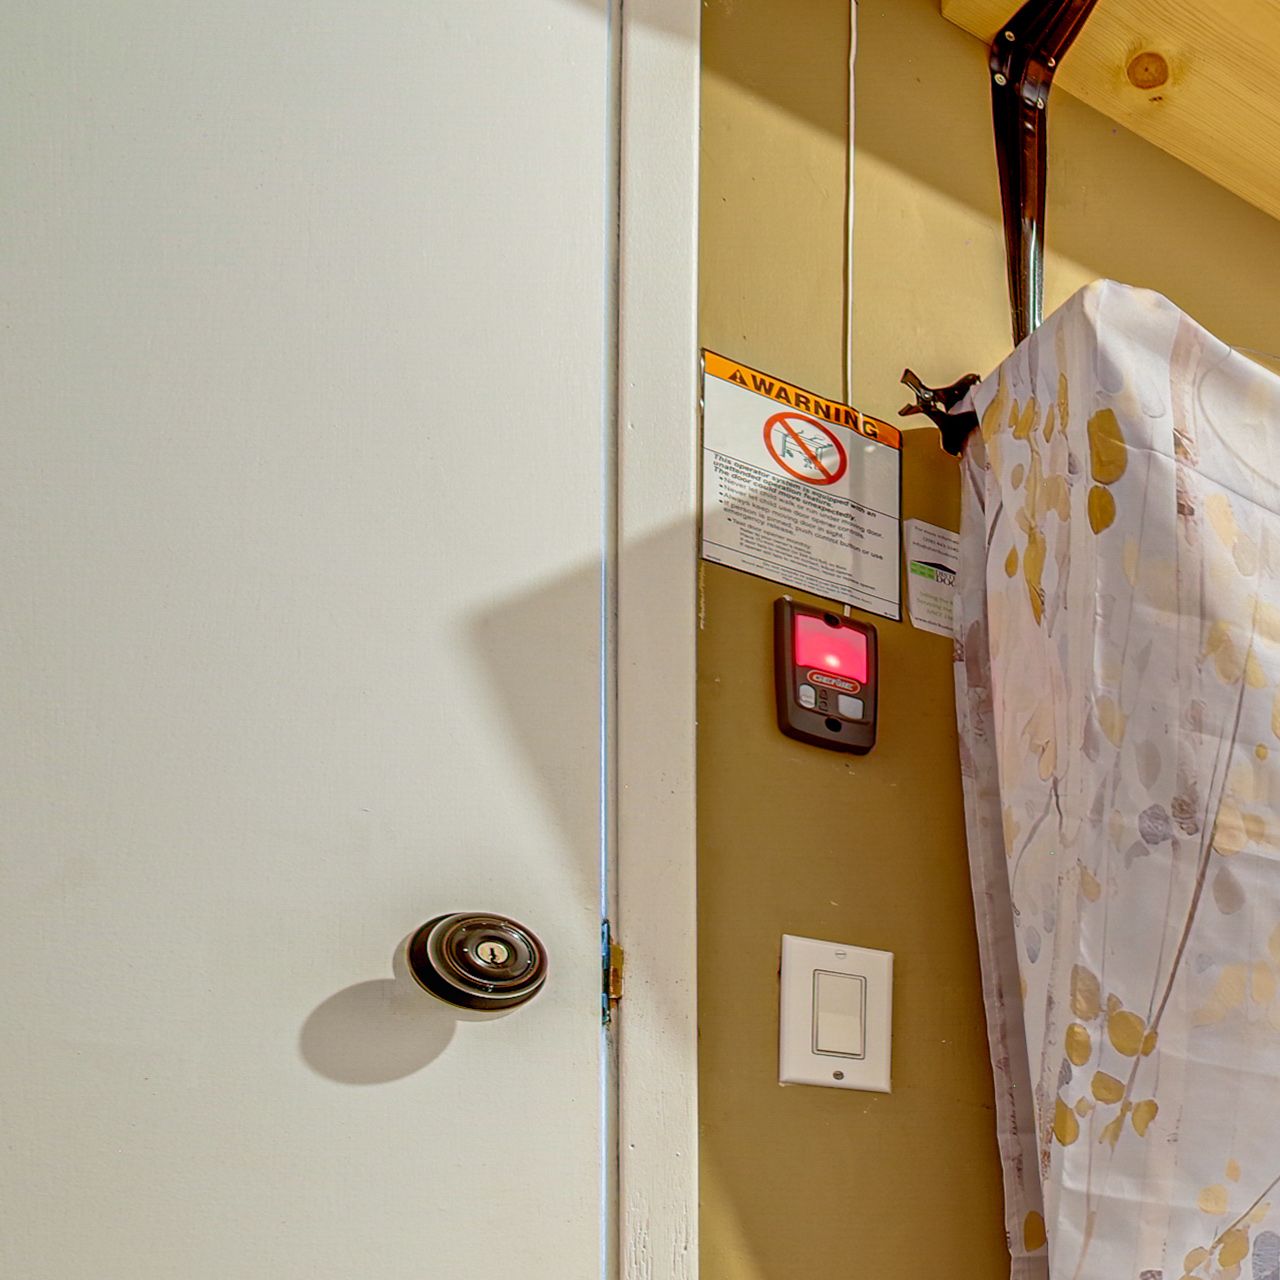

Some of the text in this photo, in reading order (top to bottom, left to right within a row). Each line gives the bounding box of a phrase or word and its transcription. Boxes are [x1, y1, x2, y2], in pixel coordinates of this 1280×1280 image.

[751, 373, 879, 439] WARNING
[712, 460, 761, 482] unattended
[713, 452, 731, 465] This
[733, 461, 768, 479] operator
[771, 476, 801, 491] system
[850, 505, 865, 513] with
[731, 472, 750, 484] door
[752, 481, 776, 494] could
